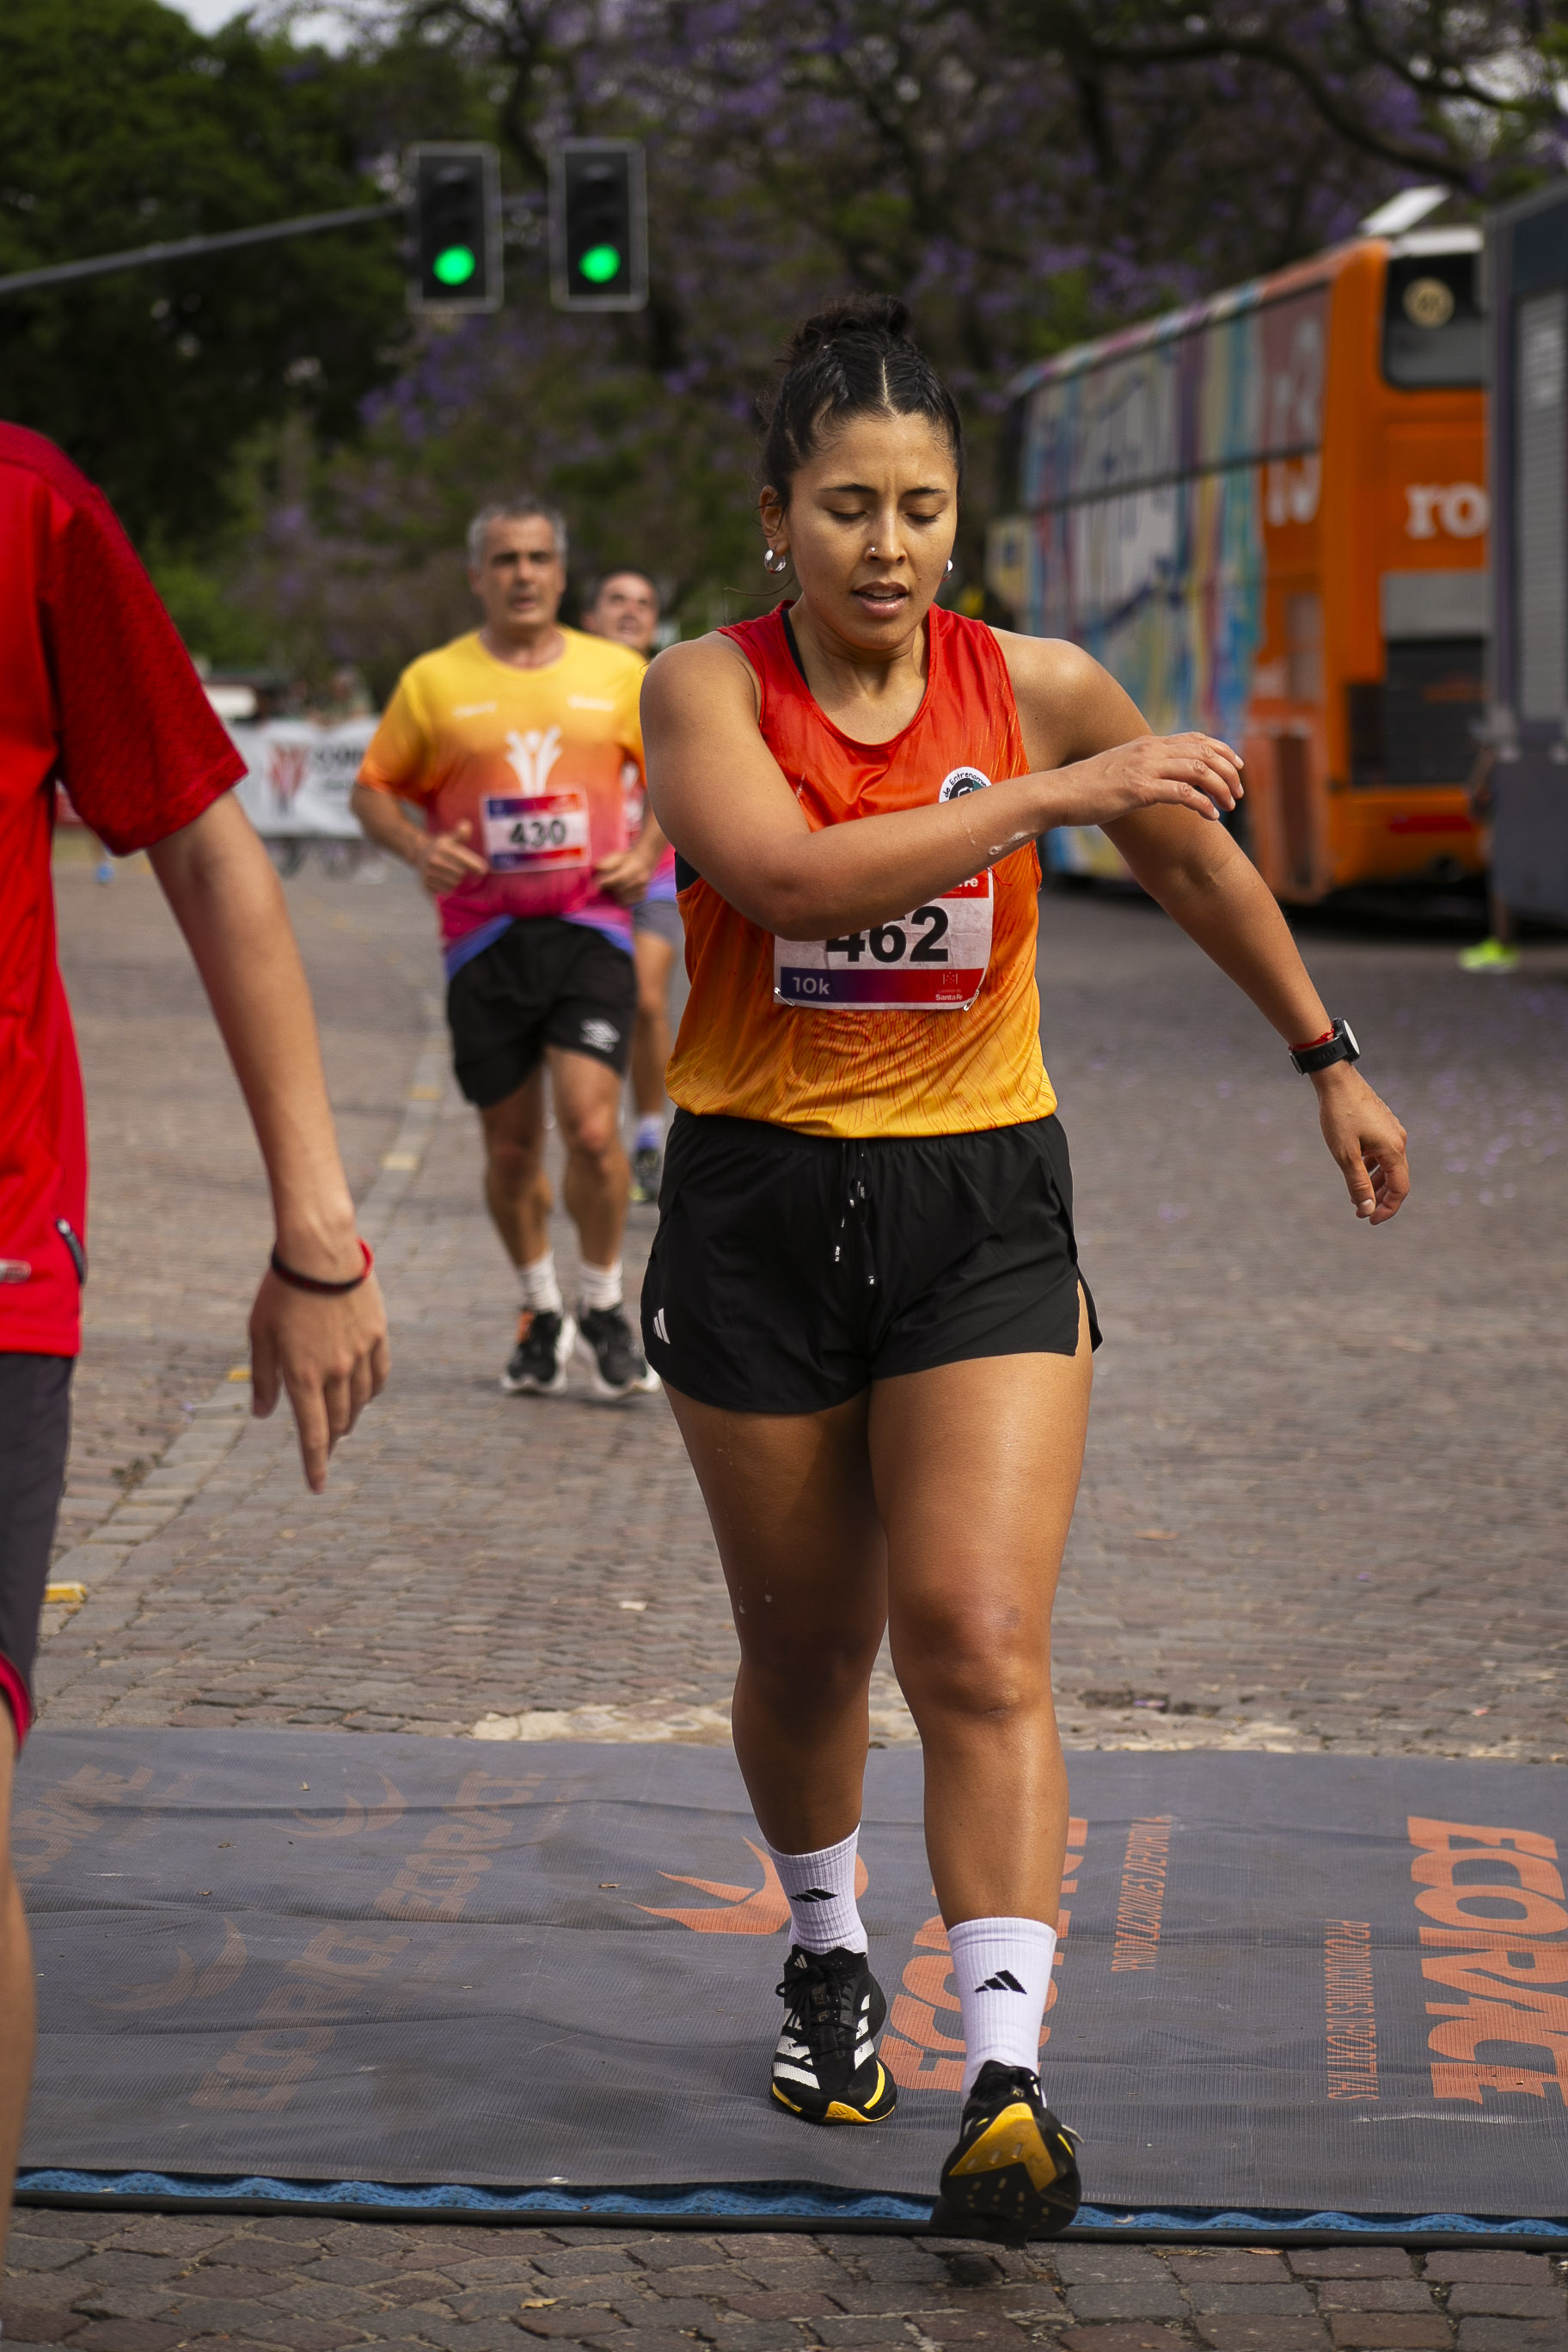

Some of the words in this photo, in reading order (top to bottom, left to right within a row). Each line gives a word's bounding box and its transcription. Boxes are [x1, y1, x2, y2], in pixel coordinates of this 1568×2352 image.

[510, 818, 567, 848] 430
[825, 905, 949, 964] 462
[793, 977, 830, 995] 10k
[1324, 1919, 1375, 2014] PRODUCCIONES
[1406, 1816, 1568, 2107] ECORACE
[1326, 2018, 1381, 2101] DEPORTIVAS
